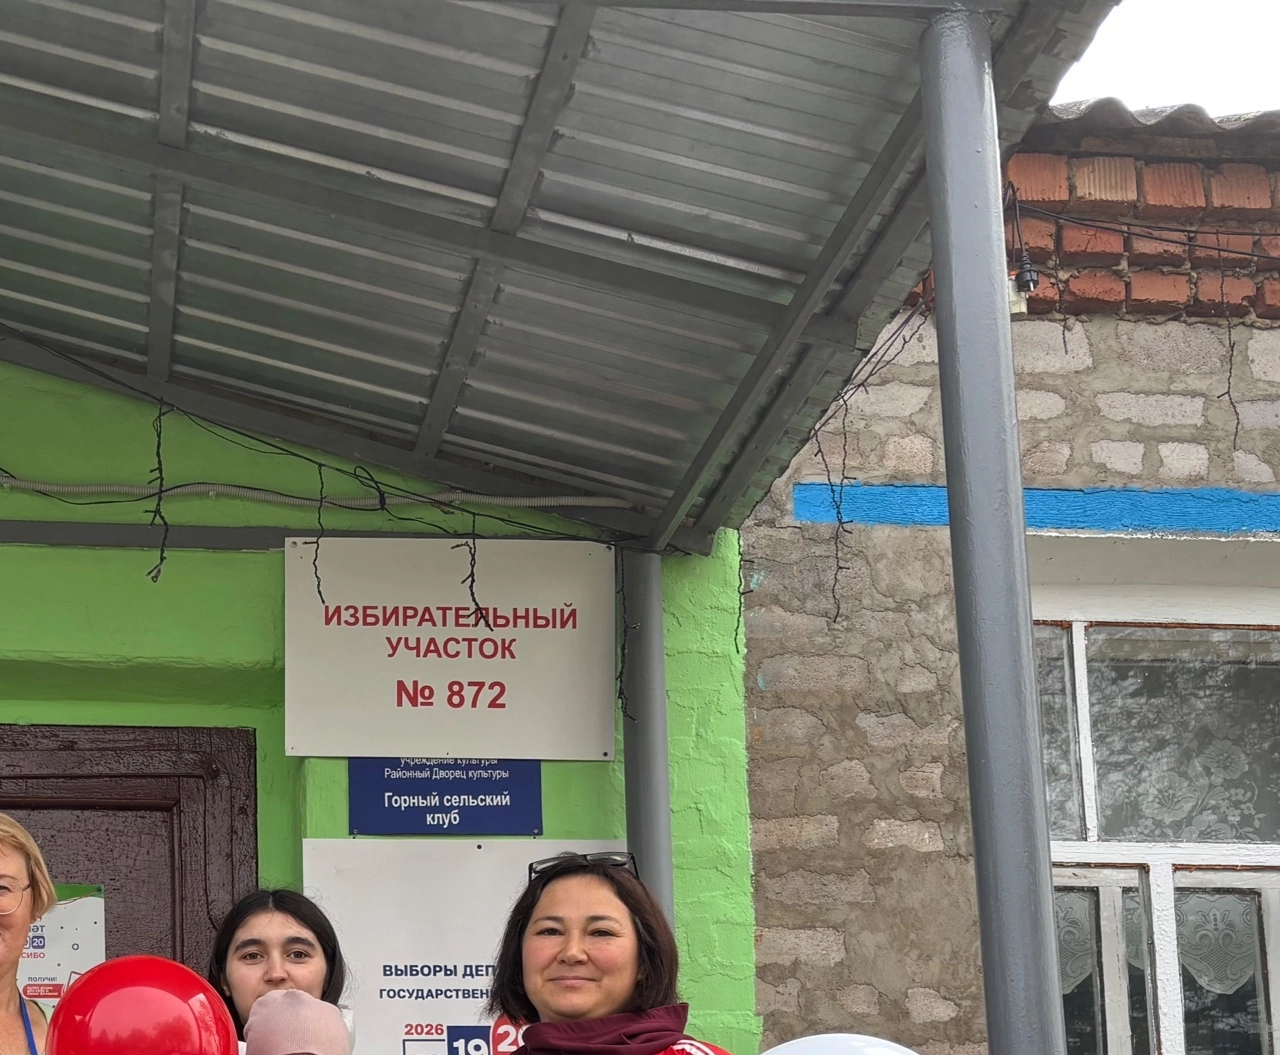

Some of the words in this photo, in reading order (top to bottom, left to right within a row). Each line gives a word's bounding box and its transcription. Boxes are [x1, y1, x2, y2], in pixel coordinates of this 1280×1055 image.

[324, 602, 577, 630] ИЗБИРАТЕЛЬНЫЙ
[386, 637, 516, 659] УЧАСТОК
[396, 679, 434, 707] №
[447, 680, 507, 709] 872
[384, 768, 431, 779] Районный
[432, 768, 466, 780] Дворец
[468, 769, 509, 780] культуры
[384, 791, 439, 811] Горный
[443, 791, 510, 806] сельский
[426, 809, 460, 828] клуб
[32, 938, 44, 947] 20
[383, 965, 457, 977] ВЫБОРЫ
[462, 964, 496, 979] ДЕП
[379, 989, 489, 1000] ГОСУДАРСТВЕН
[404, 1024, 444, 1035] 2026
